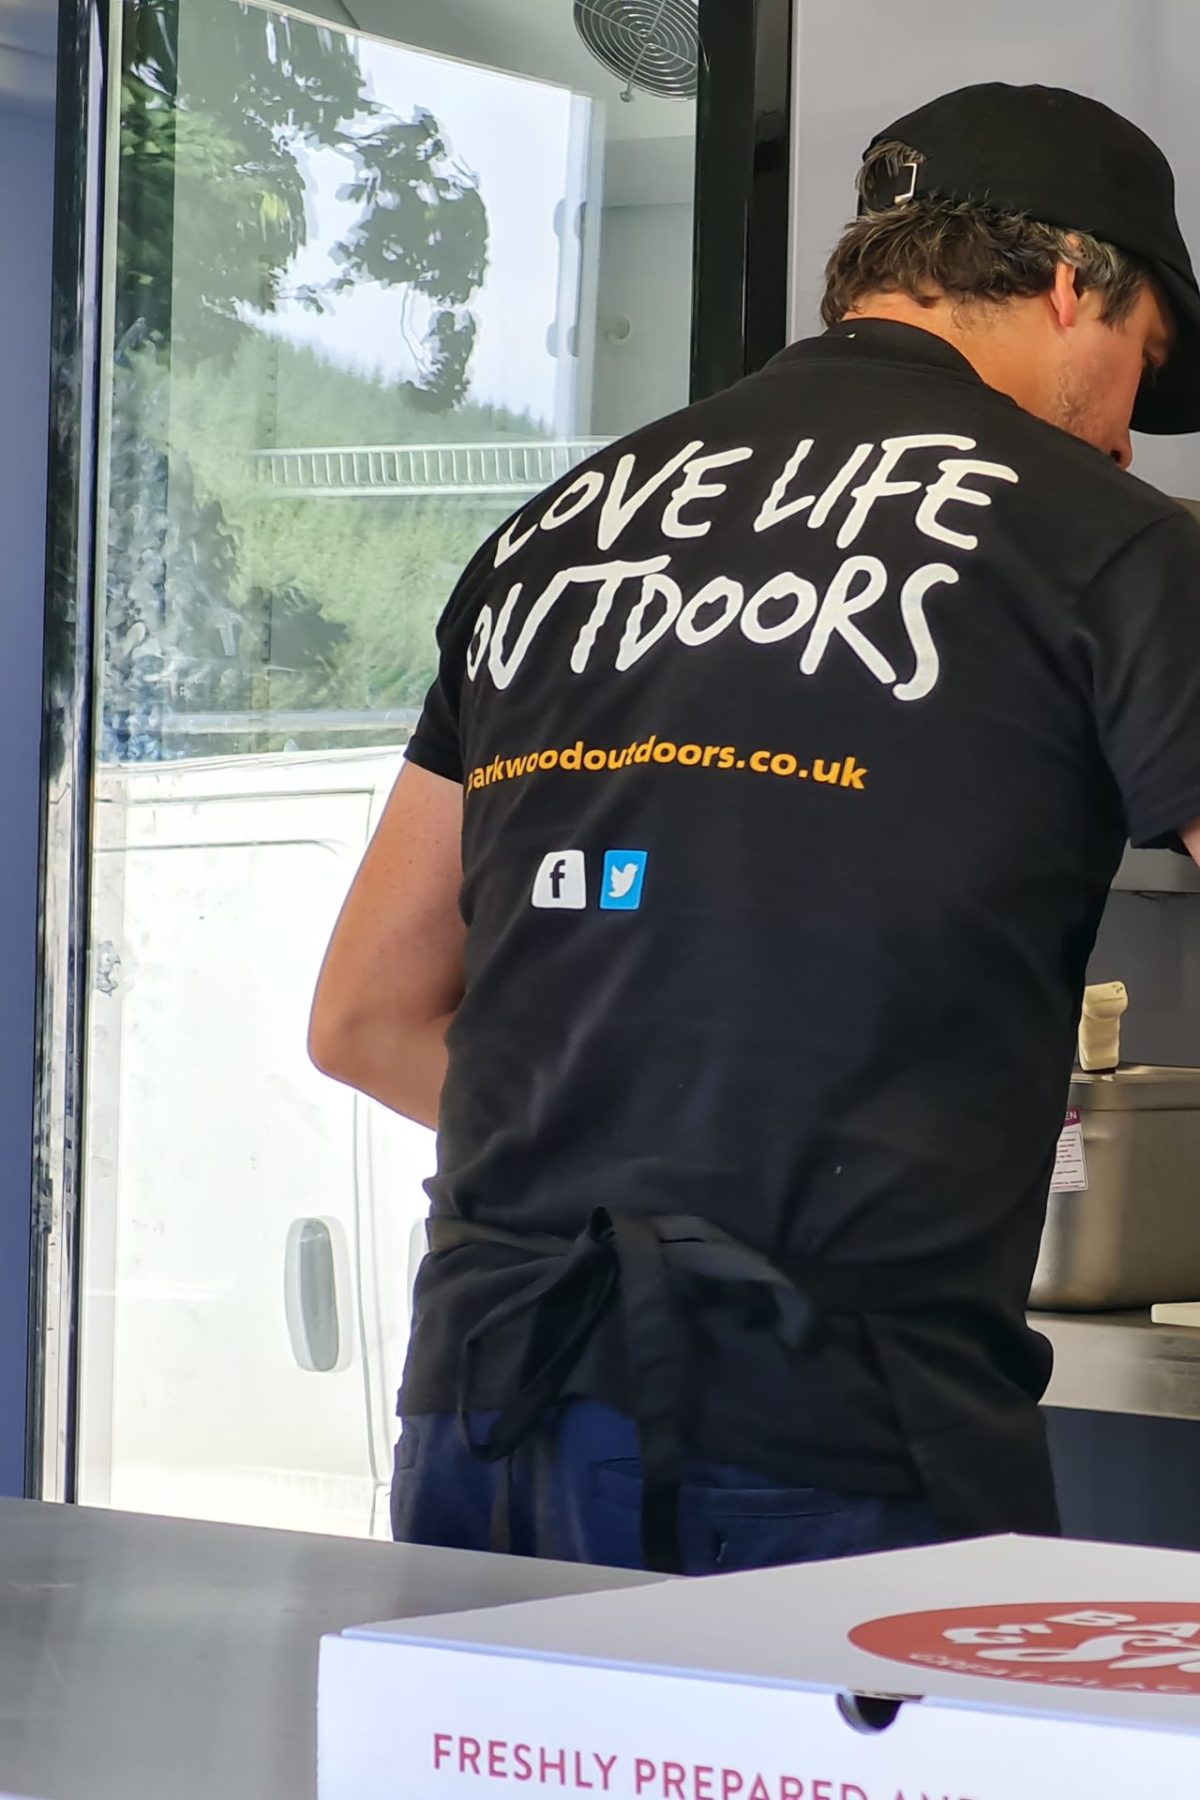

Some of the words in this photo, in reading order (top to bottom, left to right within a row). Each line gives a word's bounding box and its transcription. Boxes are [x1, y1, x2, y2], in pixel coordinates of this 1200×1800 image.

[493, 440, 753, 568] LOVE
[753, 433, 1019, 550] LIFE
[466, 555, 959, 701] OUTDOORS
[433, 1733, 618, 1790] FRESHLY
